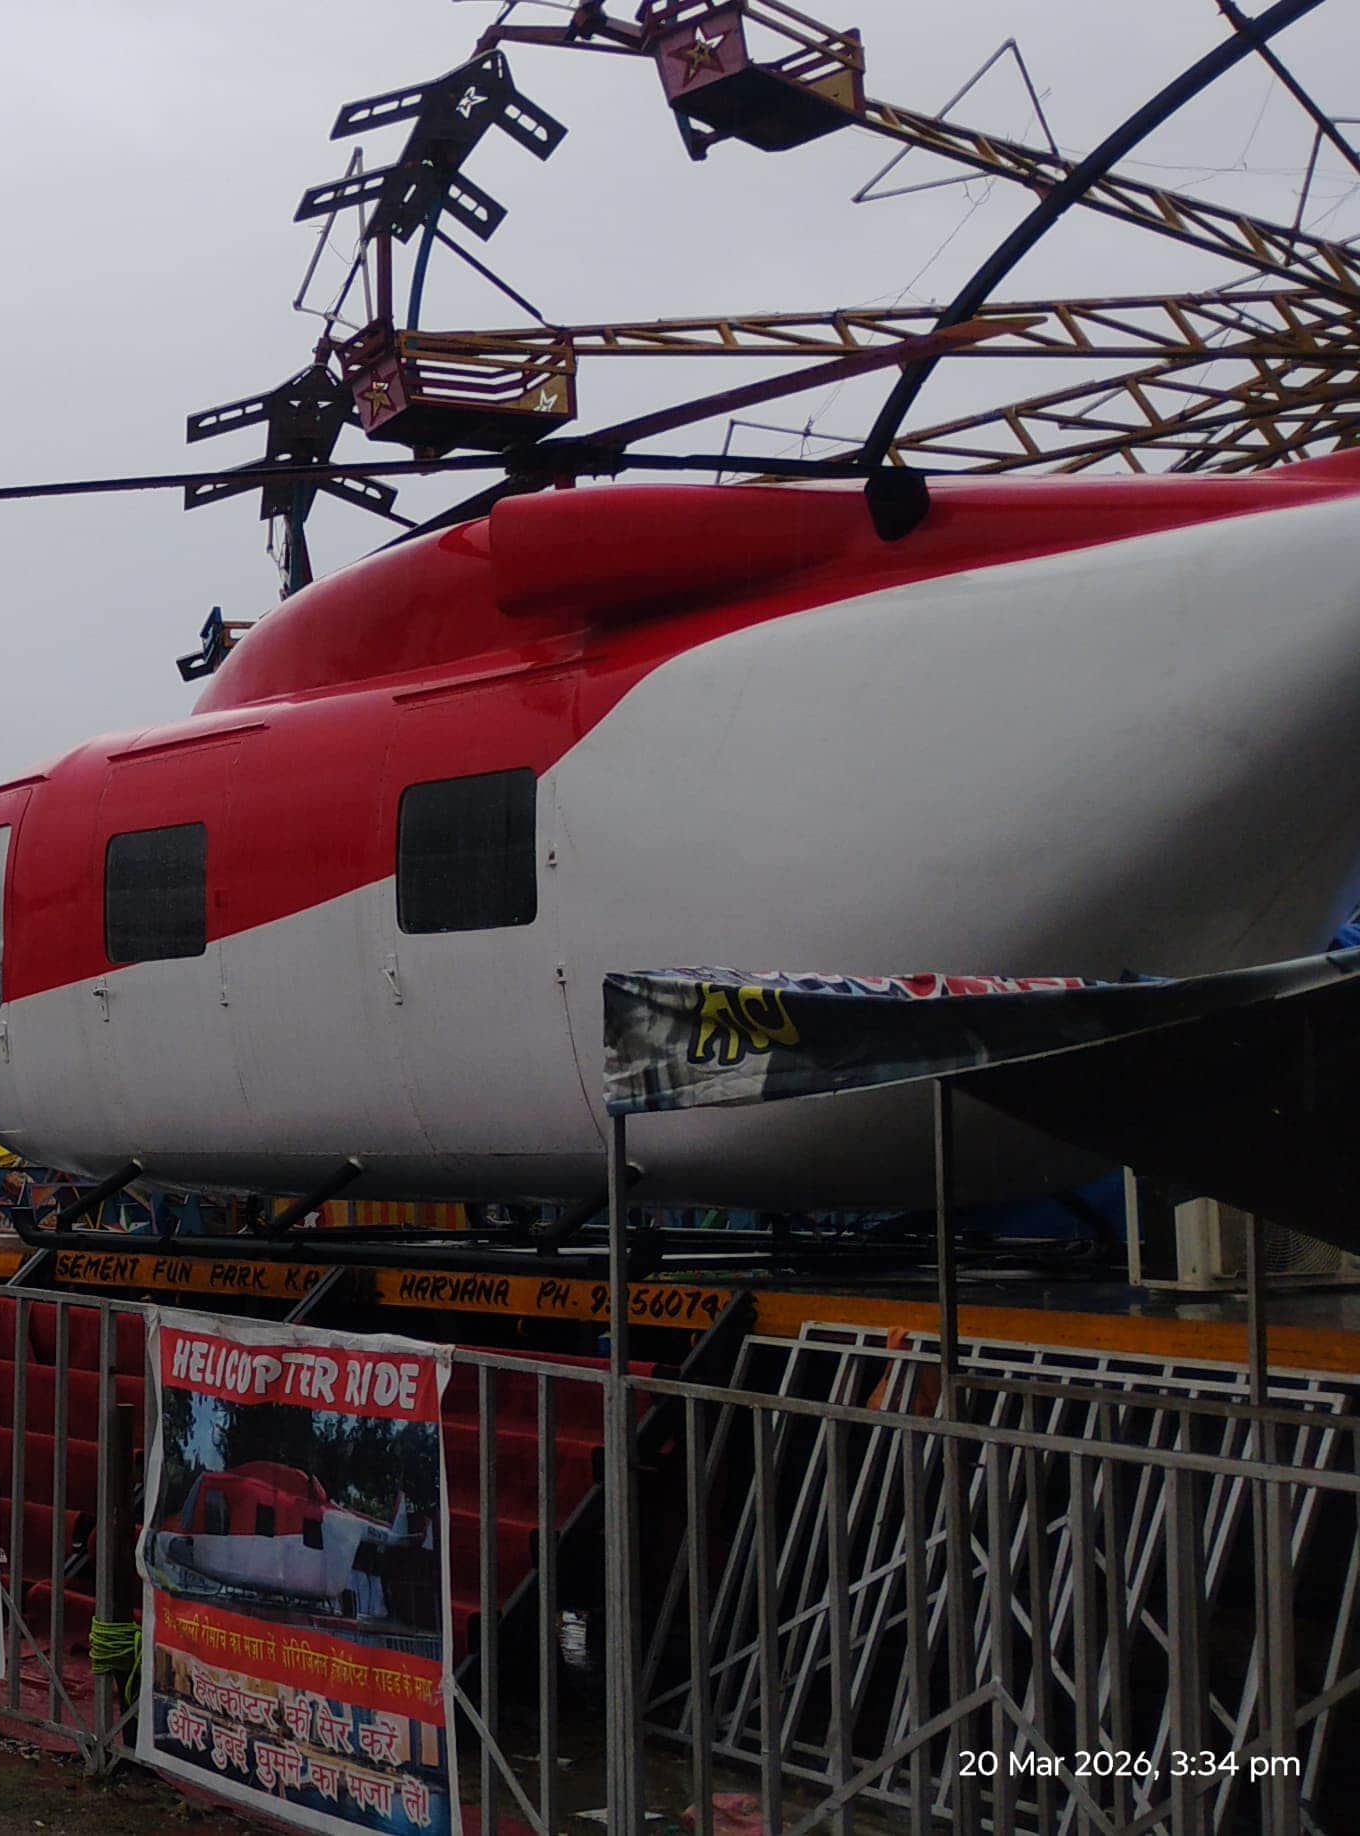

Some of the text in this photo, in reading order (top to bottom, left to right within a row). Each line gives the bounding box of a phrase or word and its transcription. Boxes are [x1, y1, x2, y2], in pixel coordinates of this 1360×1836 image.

[22, 1250, 139, 1283] SEMENT
[152, 1259, 193, 1284] FUN
[209, 1264, 270, 1291] PARK
[399, 1273, 510, 1307] HARYANA
[535, 1281, 579, 1310] PH.
[172, 1337, 420, 1410] HELICOPTER RIDE
[169, 1705, 206, 1751] और
[309, 1761, 339, 1801] का
[347, 1772, 393, 1819] मजा
[285, 1696, 312, 1739] की
[318, 1705, 353, 1753] सैर
[359, 1721, 403, 1765] करें
